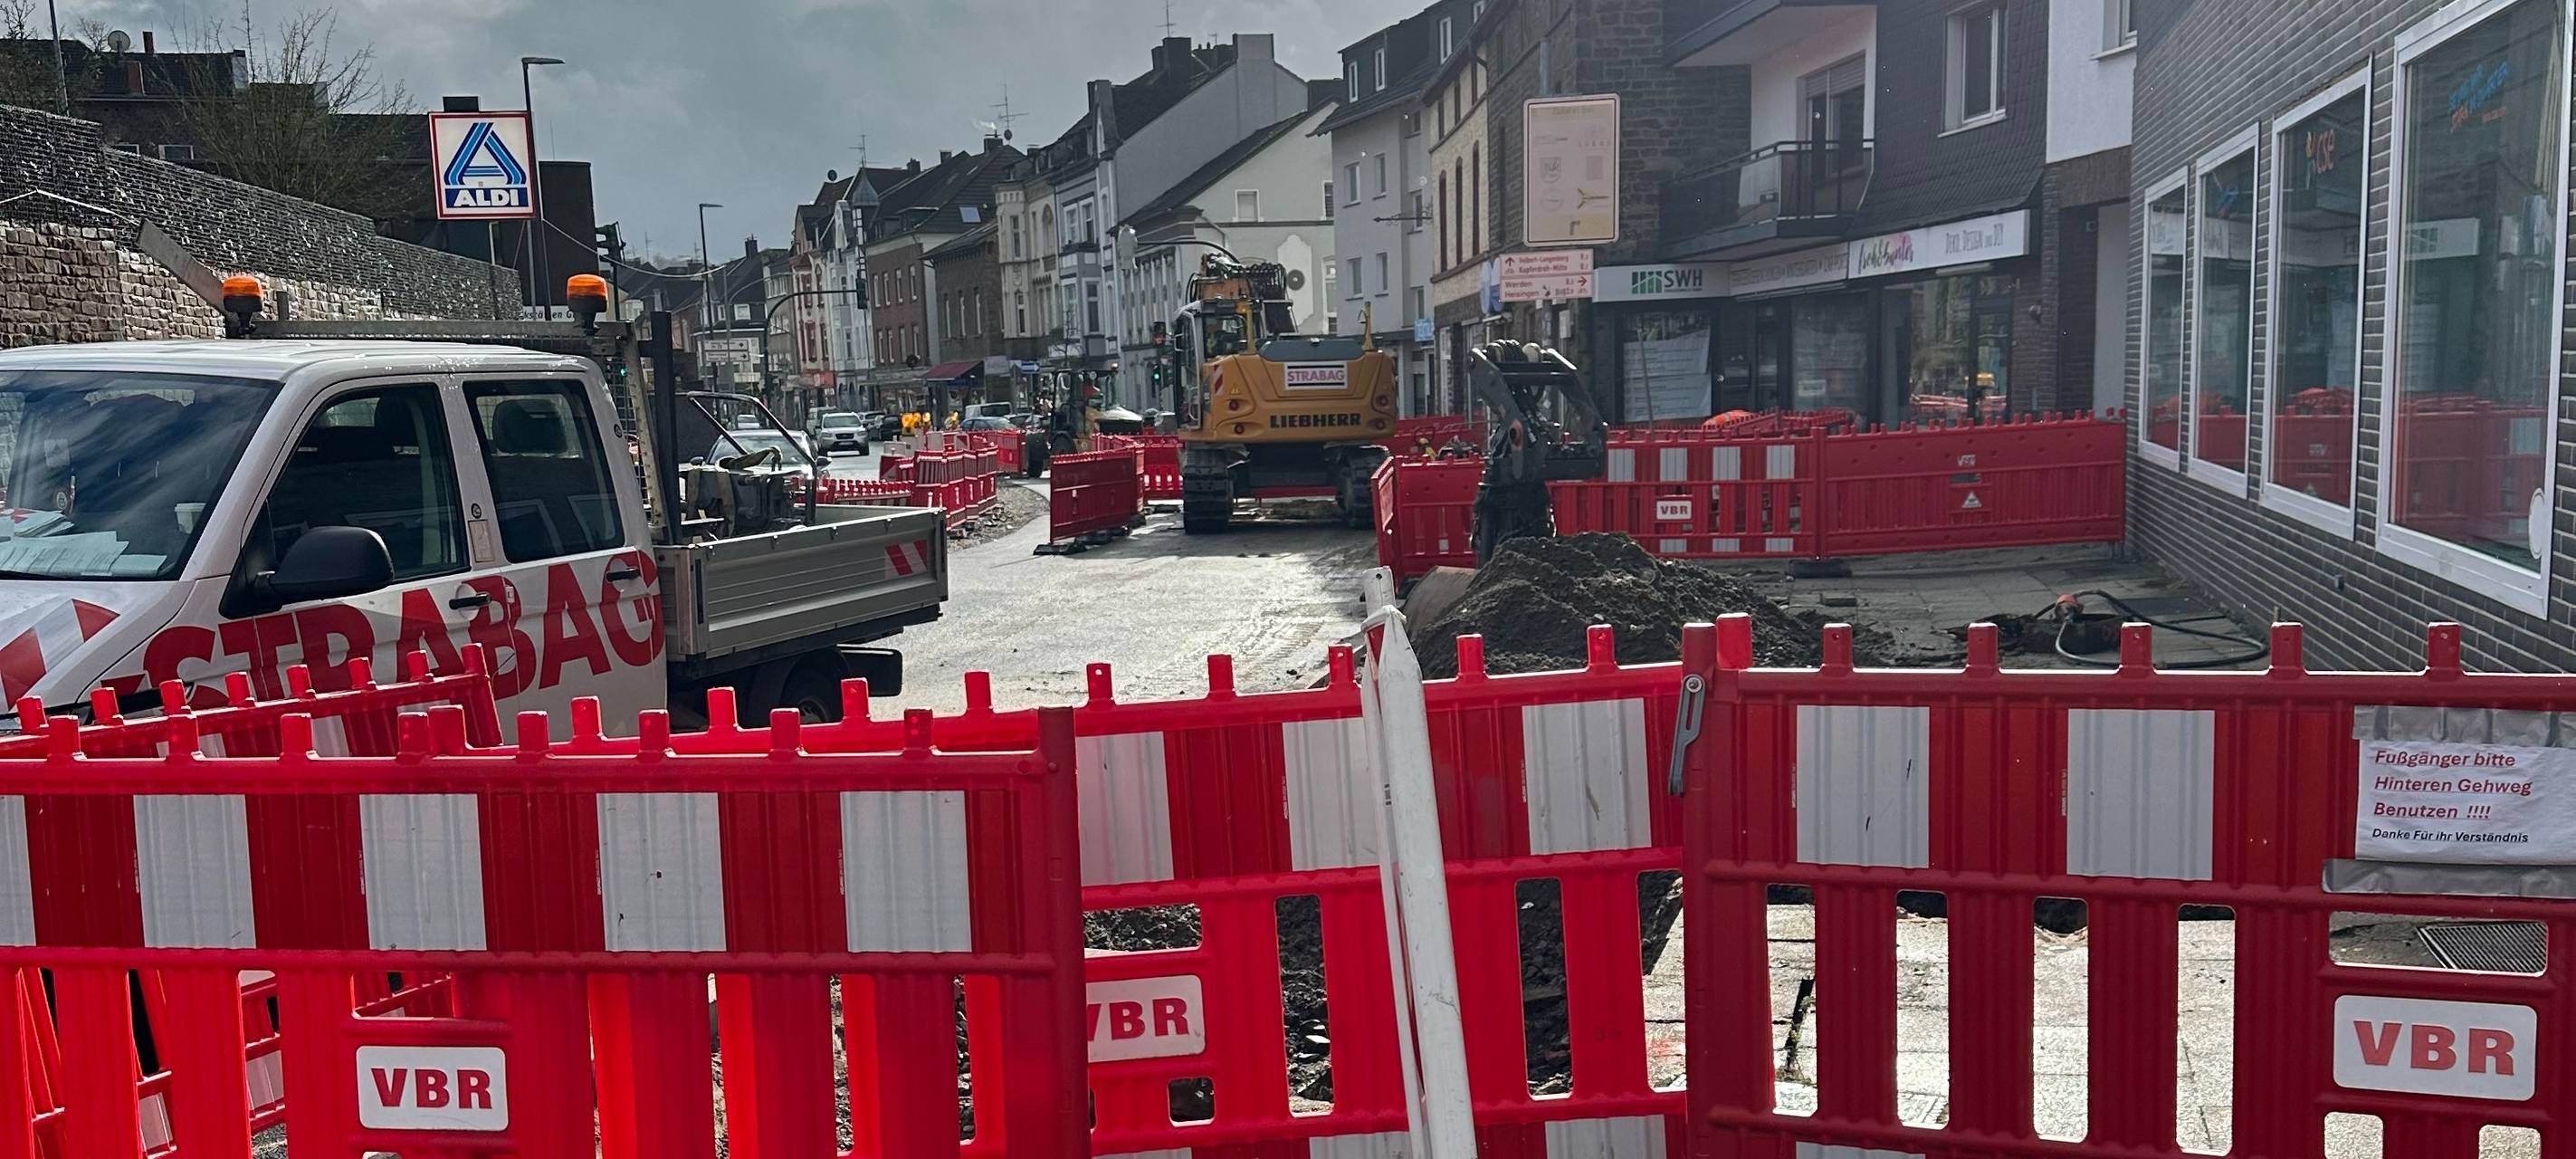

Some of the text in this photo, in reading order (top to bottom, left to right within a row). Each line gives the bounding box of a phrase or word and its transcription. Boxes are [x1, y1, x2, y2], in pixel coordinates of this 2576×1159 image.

[453, 189, 520, 207] ALDI
[1664, 269, 1703, 288] SWH
[1504, 290, 1540, 298] Heisingen
[1287, 370, 1345, 381] STRABAG
[1270, 413, 1361, 428] LIEBHERR
[1660, 505, 1688, 514] VBR
[143, 550, 665, 707] STRABAG
[2374, 750, 2516, 768] Fußgänger bitte
[2374, 776, 2533, 796] Hinteren Gehweg
[2373, 802, 2491, 819] Benutzen !!!!
[2371, 828, 2529, 843] Danke Für ihr Verständnis
[2353, 1020, 2514, 1076] VBR
[370, 1068, 492, 1109] VBR
